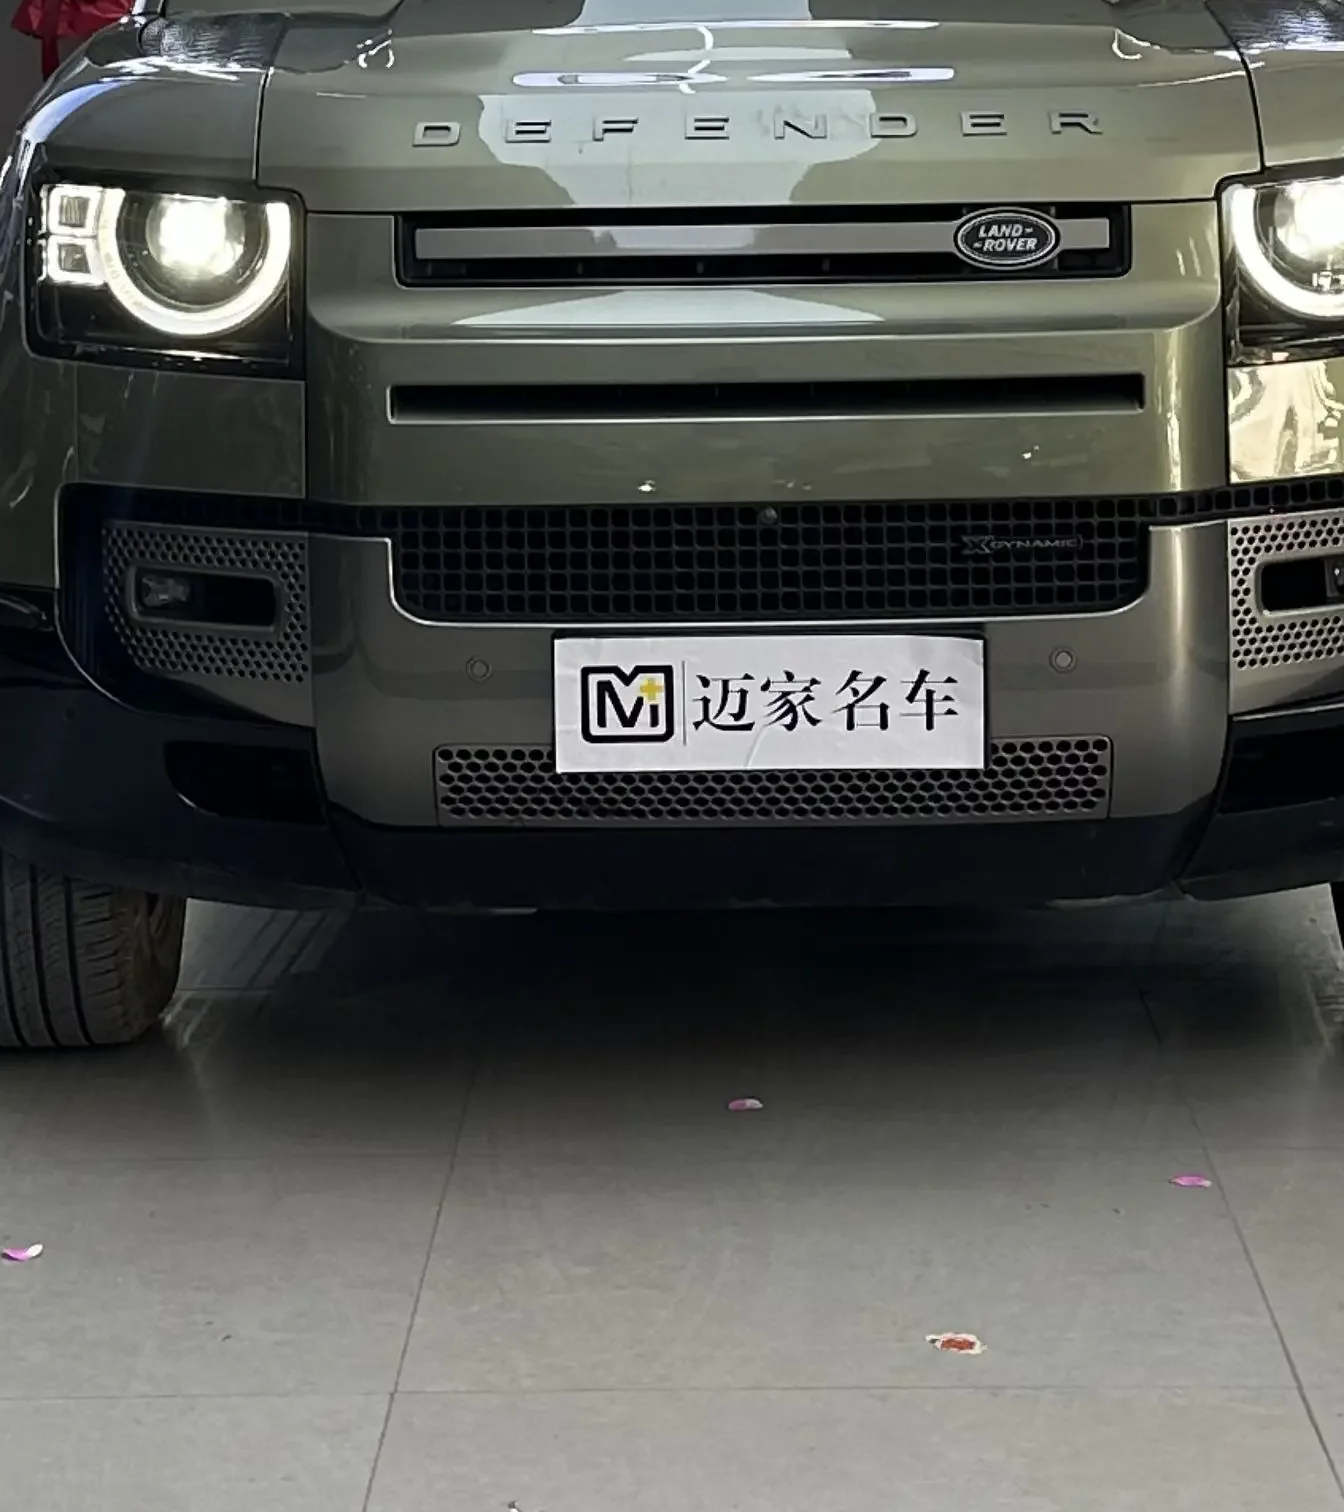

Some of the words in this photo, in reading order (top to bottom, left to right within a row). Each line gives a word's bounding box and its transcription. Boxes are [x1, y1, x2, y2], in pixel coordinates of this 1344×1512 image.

[411, 109, 1104, 148] DEFENDER
[978, 223, 1024, 238] LAND
[982, 237, 1038, 252] ROVER
[691, 668, 960, 733] 迈家名车
